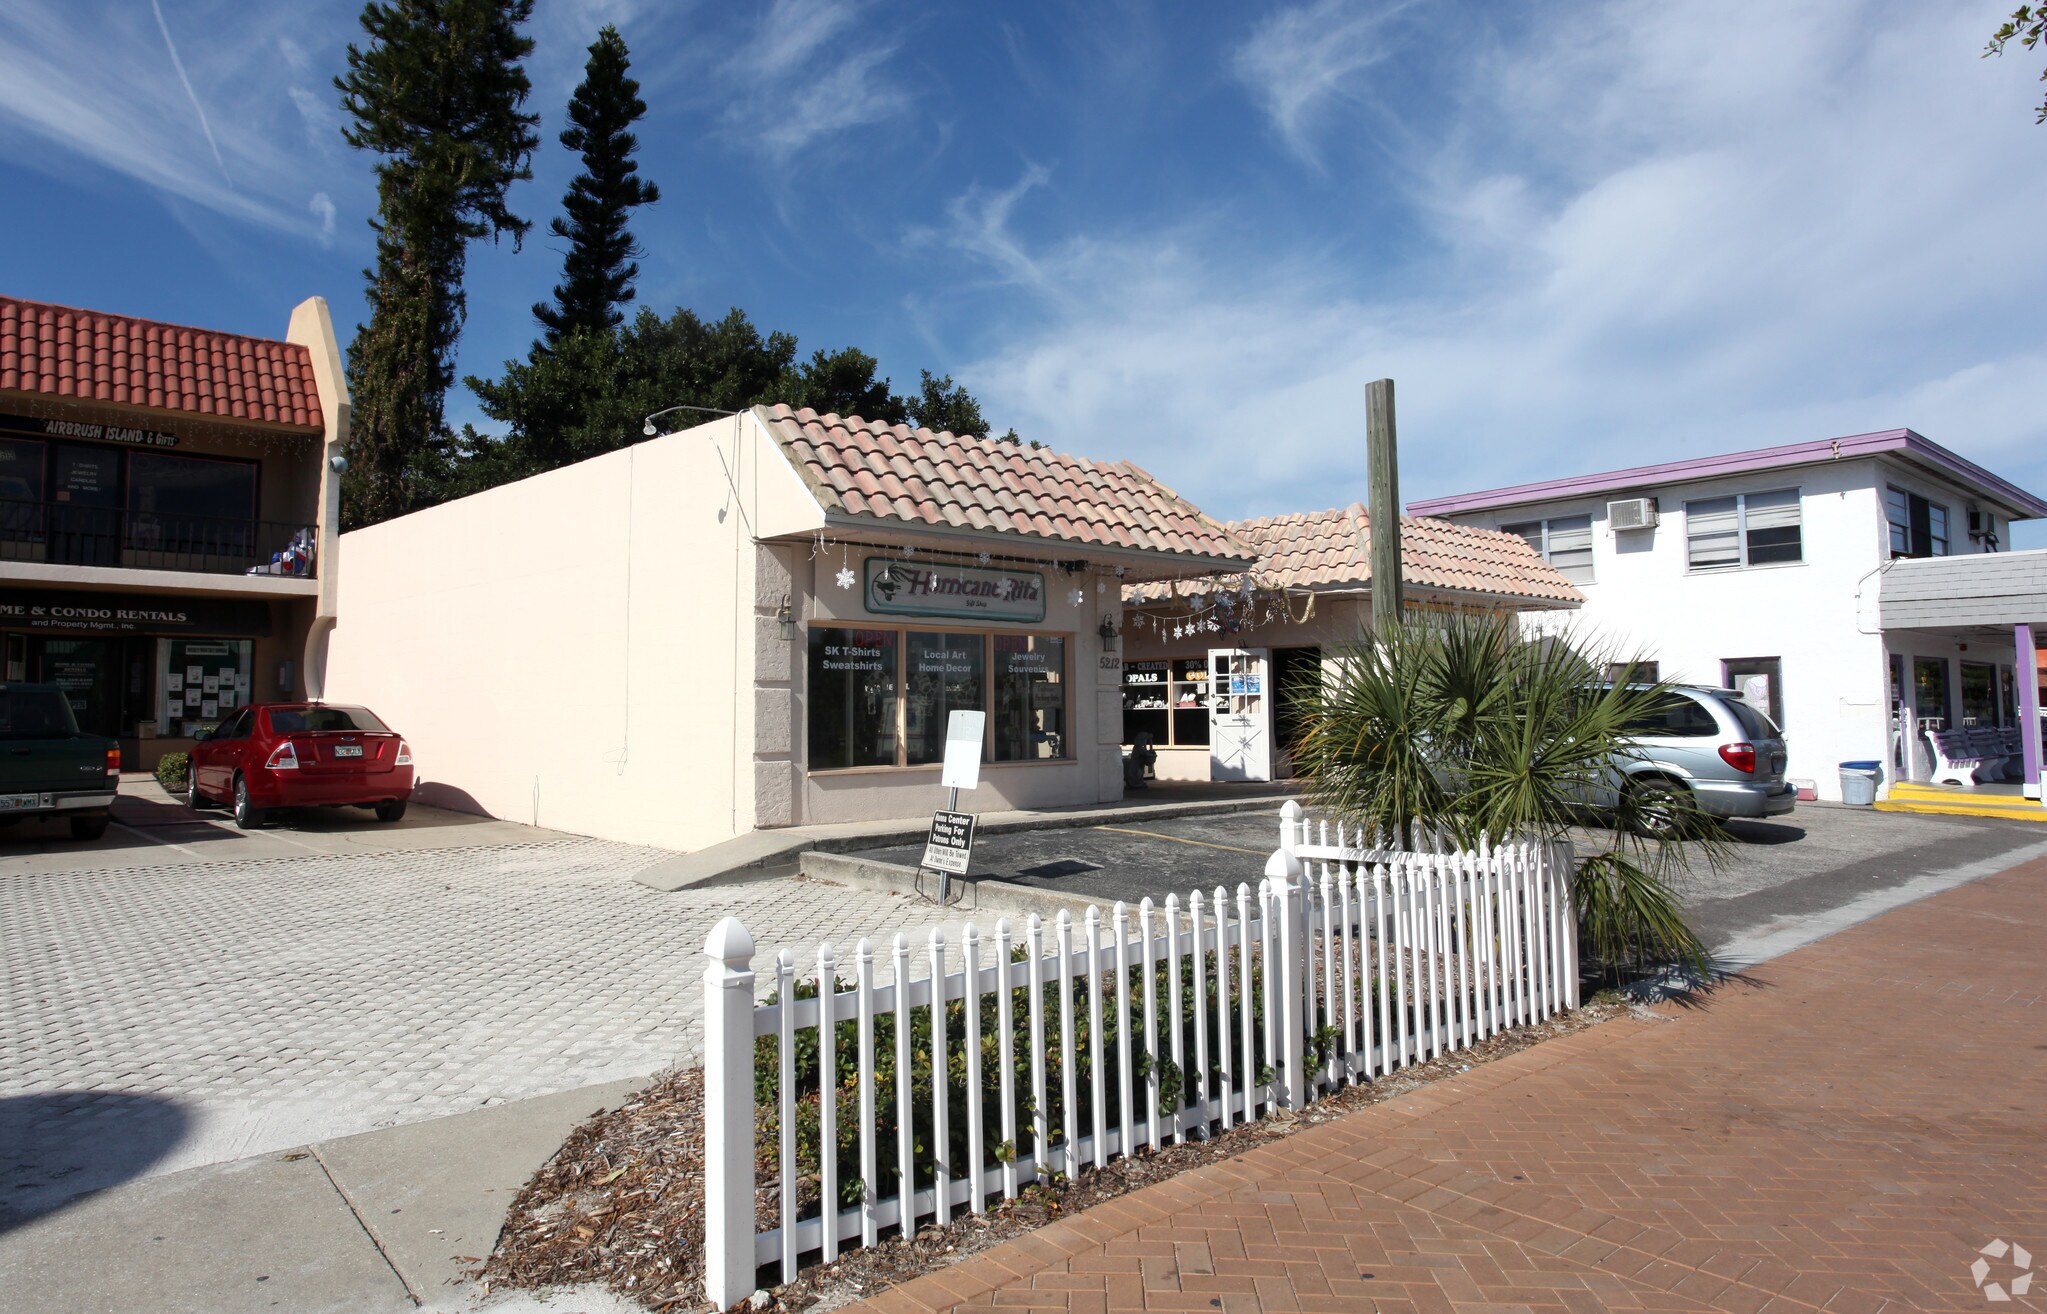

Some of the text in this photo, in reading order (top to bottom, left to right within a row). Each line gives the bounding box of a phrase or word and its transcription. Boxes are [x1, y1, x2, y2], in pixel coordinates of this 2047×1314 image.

[45, 420, 102, 439] AIRBRUSH
[105, 426, 143, 443] ISLAND
[147, 431, 153, 444] &
[1003, 578, 1039, 602] Rita
[30, 606, 47, 616] &
[50, 607, 111, 619] CONDO
[116, 609, 188, 622] RENTALS
[50, 620, 88, 629] Property
[854, 630, 894, 648] OPEN
[994, 635, 1028, 652] OPEN
[825, 645, 881, 658] SK T-Shirts
[923, 650, 967, 661] Local Art
[1011, 652, 1046, 663] Jewelry
[822, 659, 883, 671] Sweatshirts
[918, 662, 972, 673] Home Decor
[1007, 663, 1050, 674] Souvenirs
[1099, 656, 1120, 670] 5212
[1137, 661, 1168, 671] CREATED
[1185, 660, 1201, 670] 30%
[1125, 673, 1158, 683] OPALS
[948, 814, 970, 826] Center
[935, 823, 965, 836] Parking For
[932, 833, 966, 849] Patrons Only
[949, 849, 955, 857] Be
[946, 858, 962, 868] Expense
